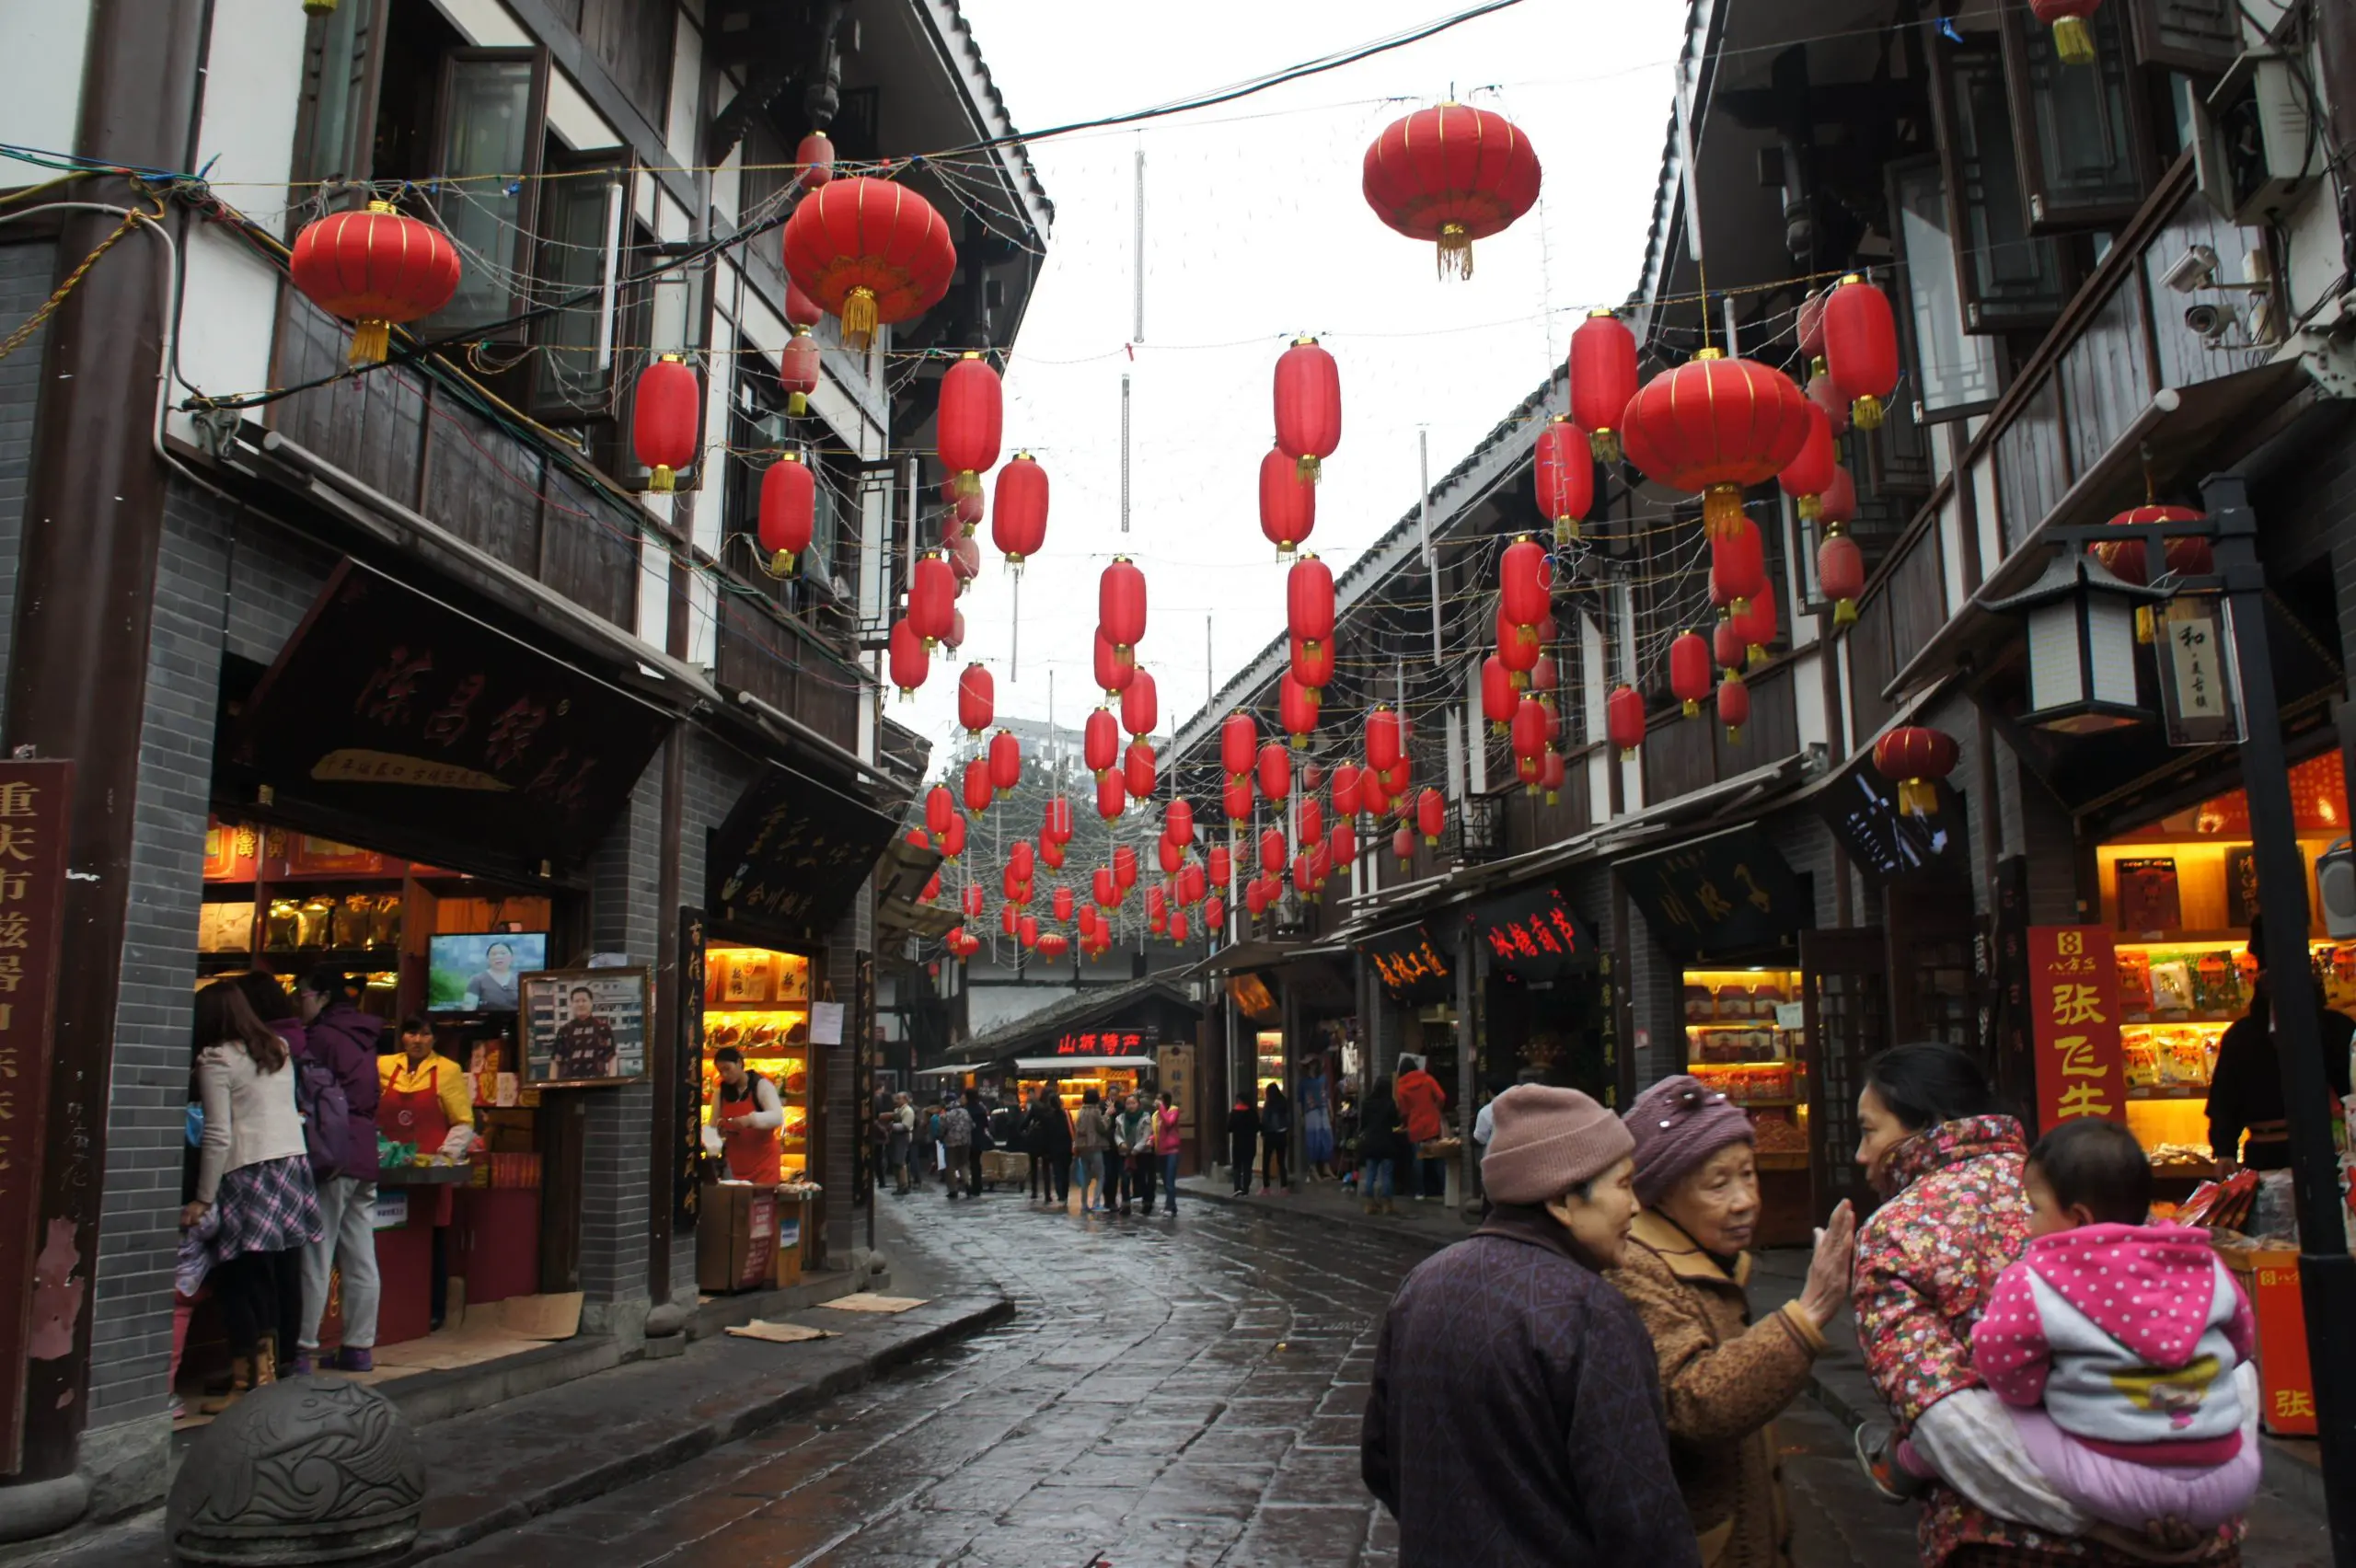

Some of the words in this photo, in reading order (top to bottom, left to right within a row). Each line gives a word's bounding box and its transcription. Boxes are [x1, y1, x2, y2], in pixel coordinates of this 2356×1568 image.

[1486, 906, 1576, 961] 冰糖葫芦
[1057, 1032, 1141, 1055] 山城特产
[2275, 1389, 2316, 1417] 张
